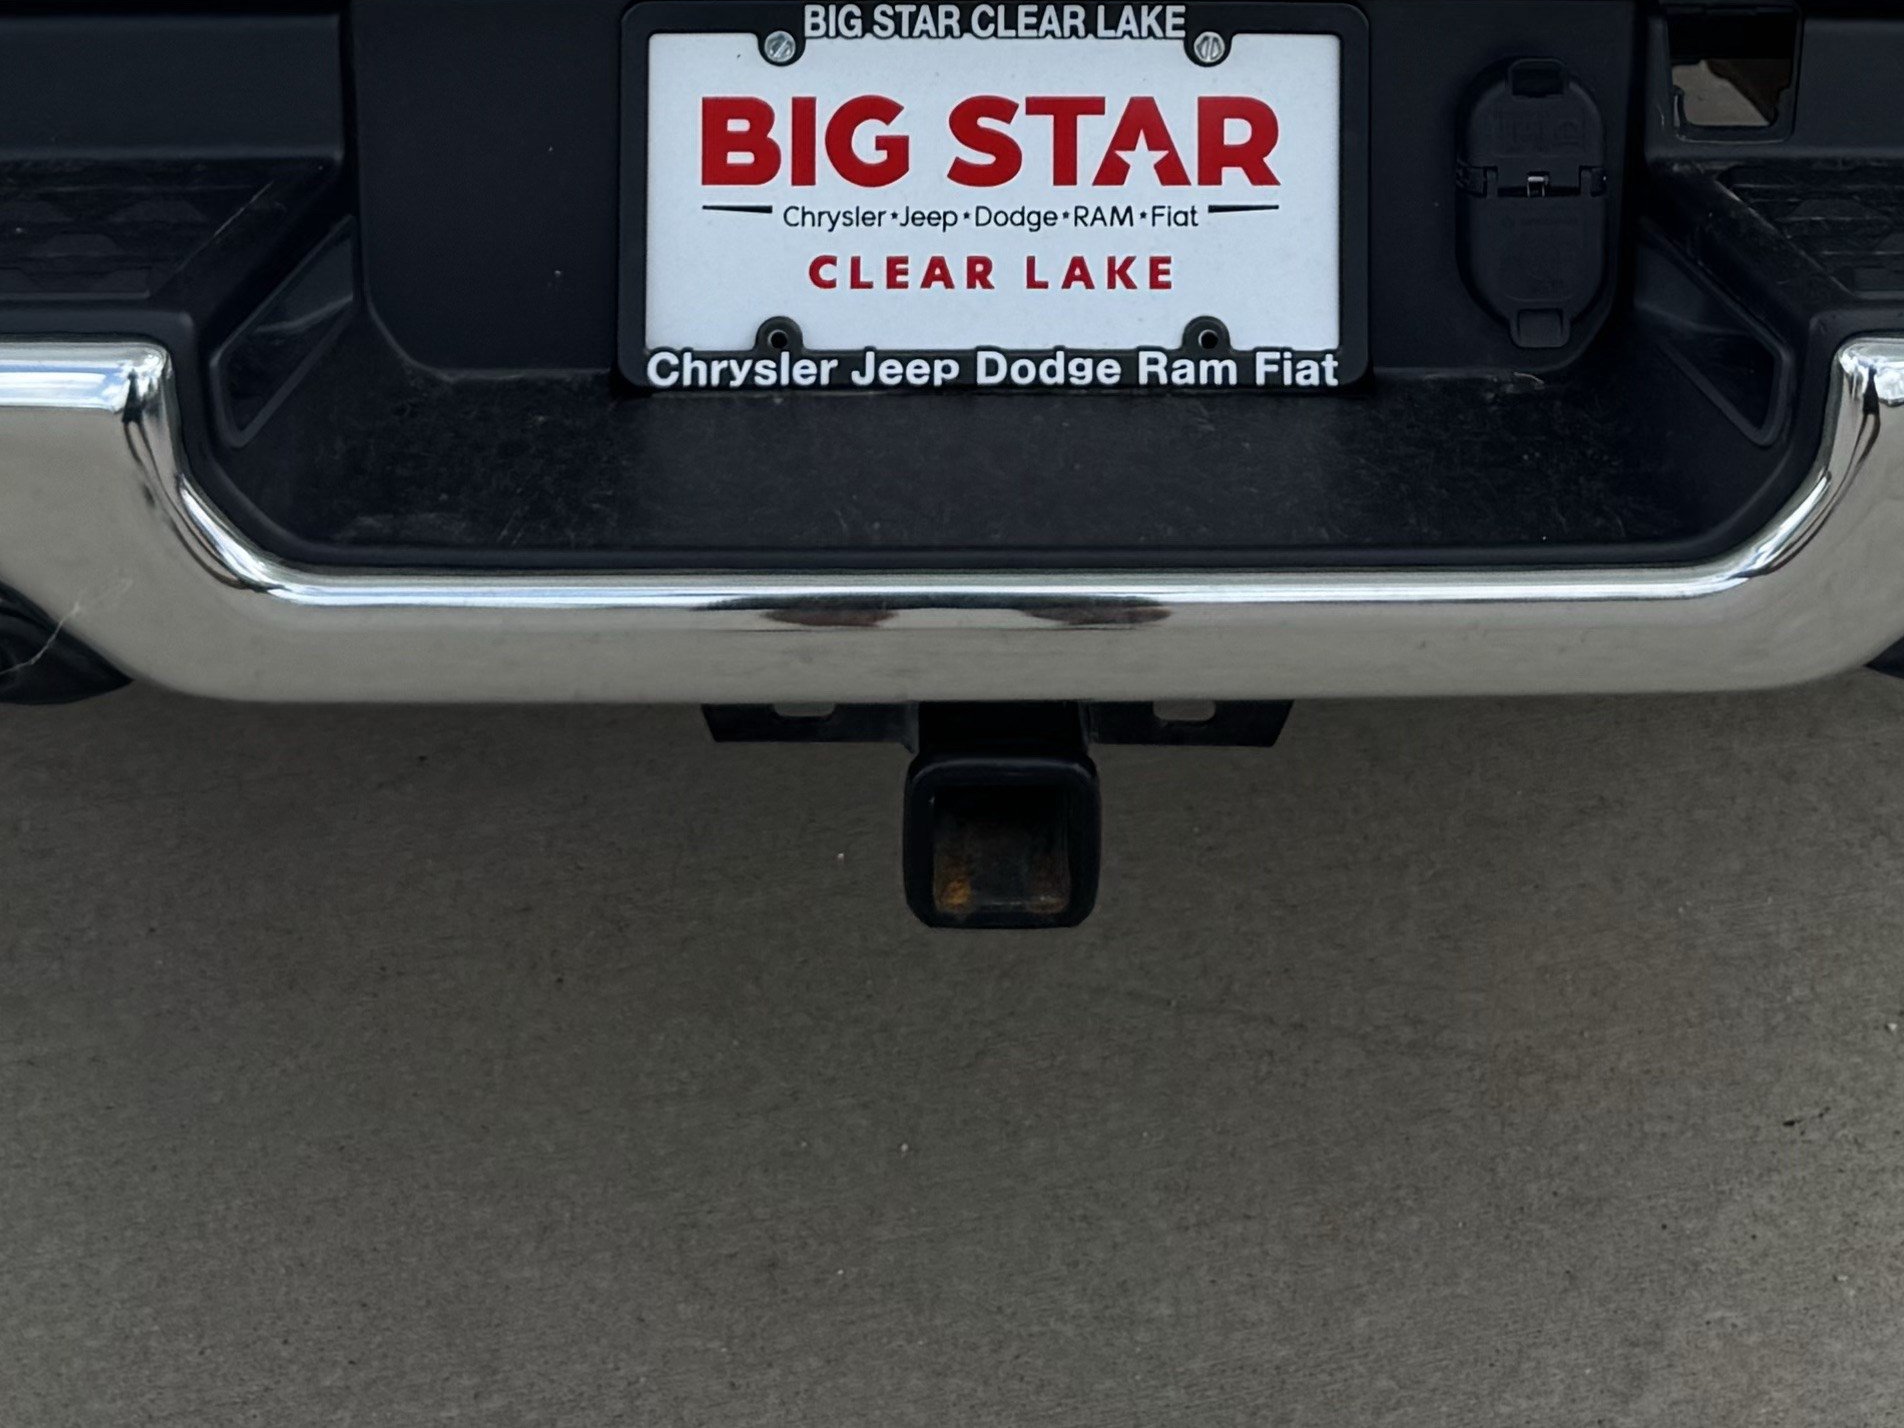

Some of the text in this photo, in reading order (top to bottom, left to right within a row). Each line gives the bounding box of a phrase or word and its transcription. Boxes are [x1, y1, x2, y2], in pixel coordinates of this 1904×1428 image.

[803, 4, 1187, 40] BIG STAR CLEAR LAKE
[701, 94, 1282, 187] BIG STAR
[783, 205, 1199, 233] Chrysler Jeep Dodge RAM Fiat
[808, 255, 1174, 290] CLEAR LAKE
[646, 351, 1339, 389] Chrysler Jeep Dodge Ram Fiat
